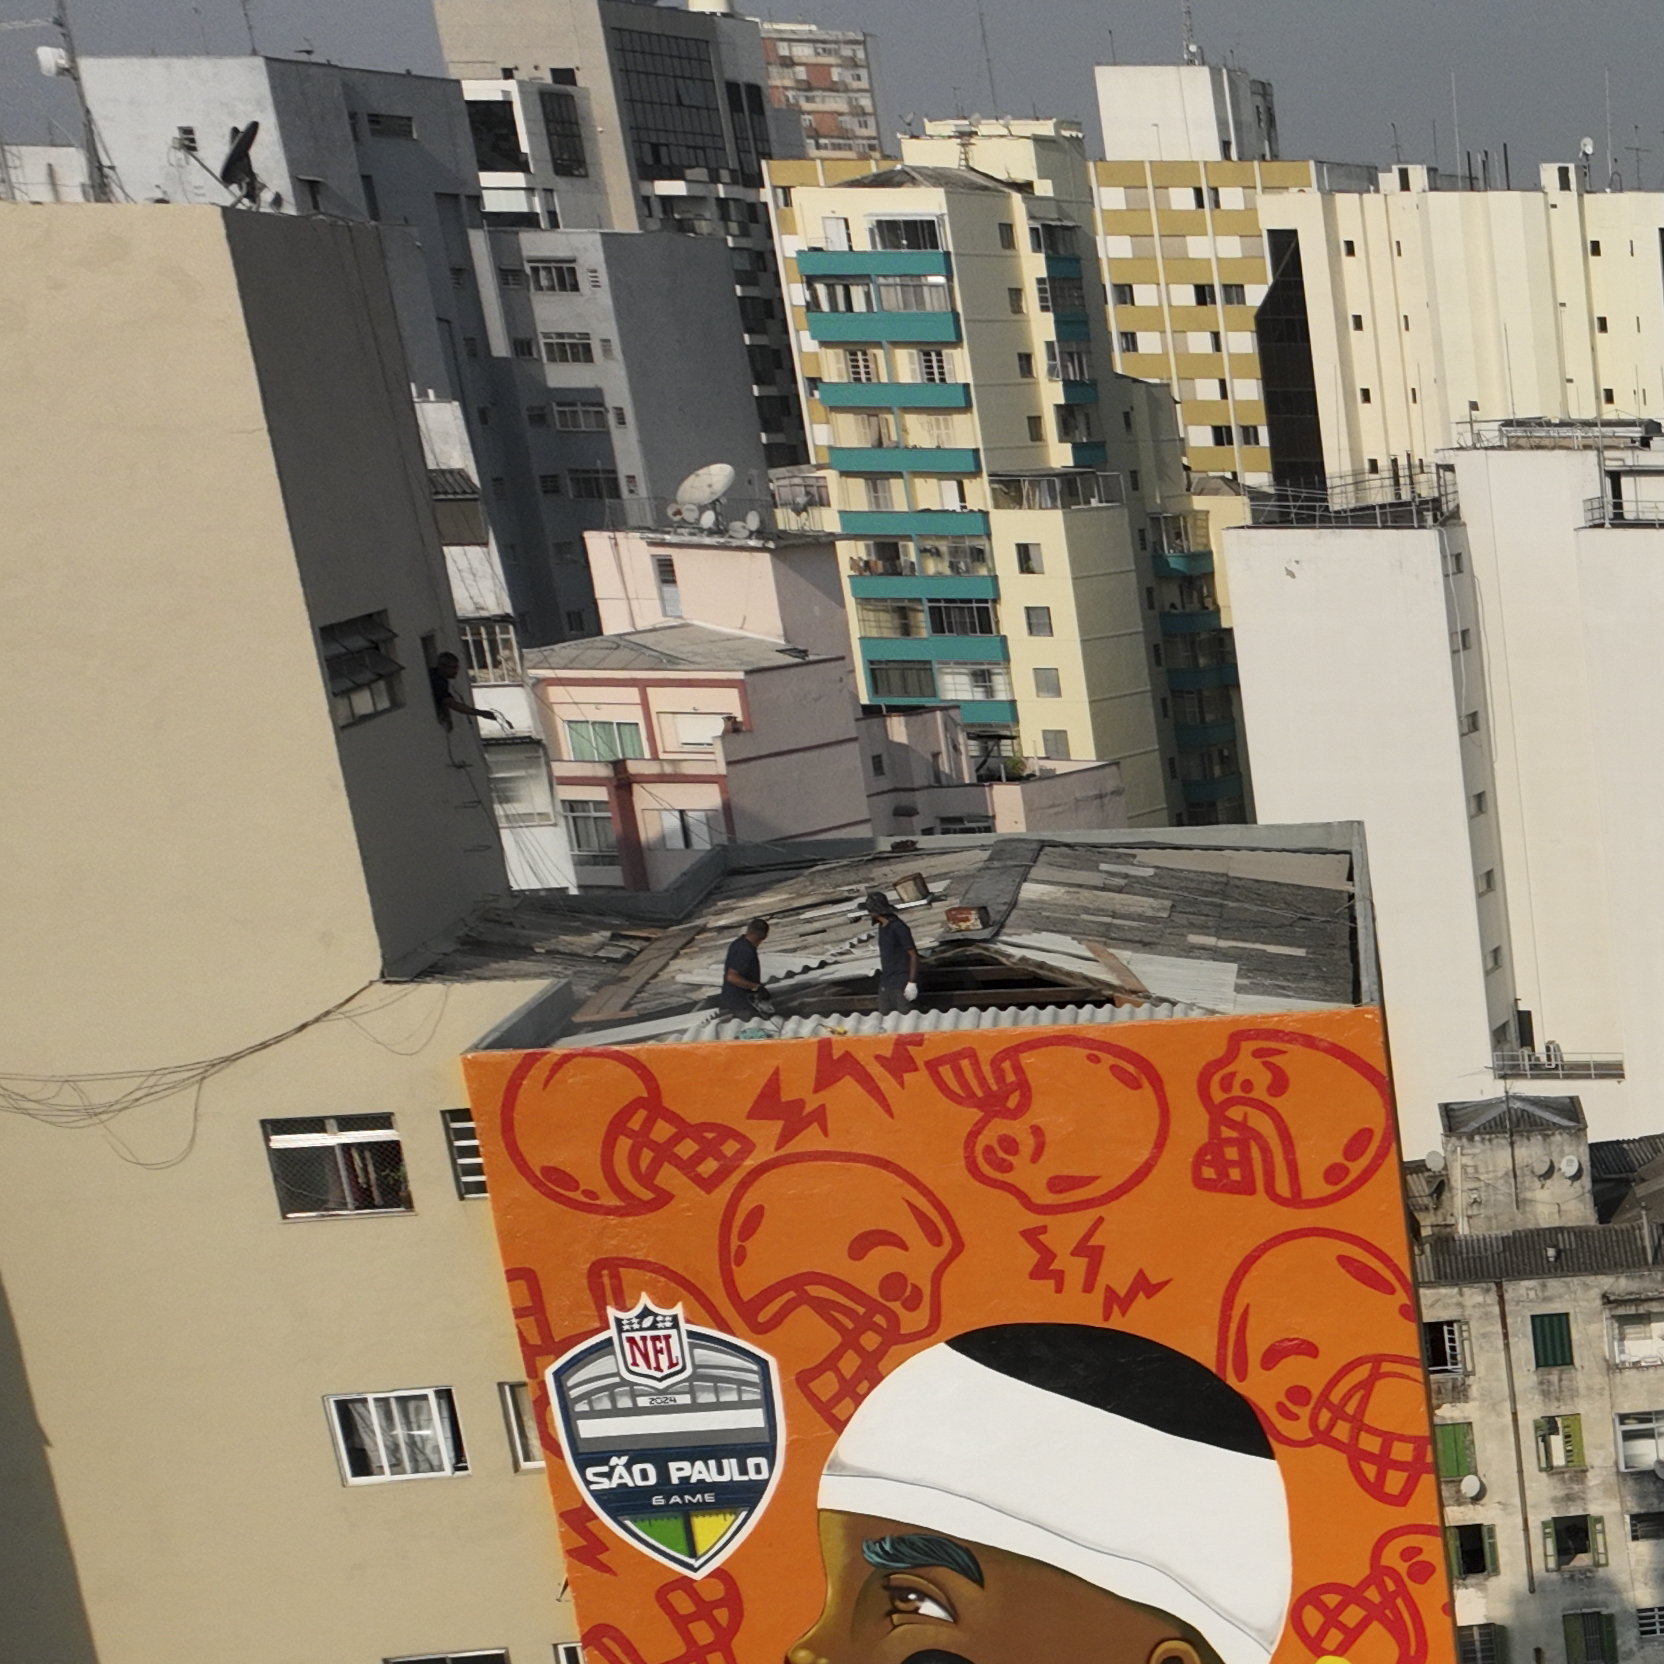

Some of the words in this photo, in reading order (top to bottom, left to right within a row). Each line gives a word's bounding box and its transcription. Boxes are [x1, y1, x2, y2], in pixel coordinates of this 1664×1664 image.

[625, 1334, 680, 1373] NFL
[648, 1396, 677, 1405] 2024
[586, 1456, 657, 1490] SÃO
[668, 1457, 770, 1485] PAULO
[652, 1493, 716, 1506] GAME
